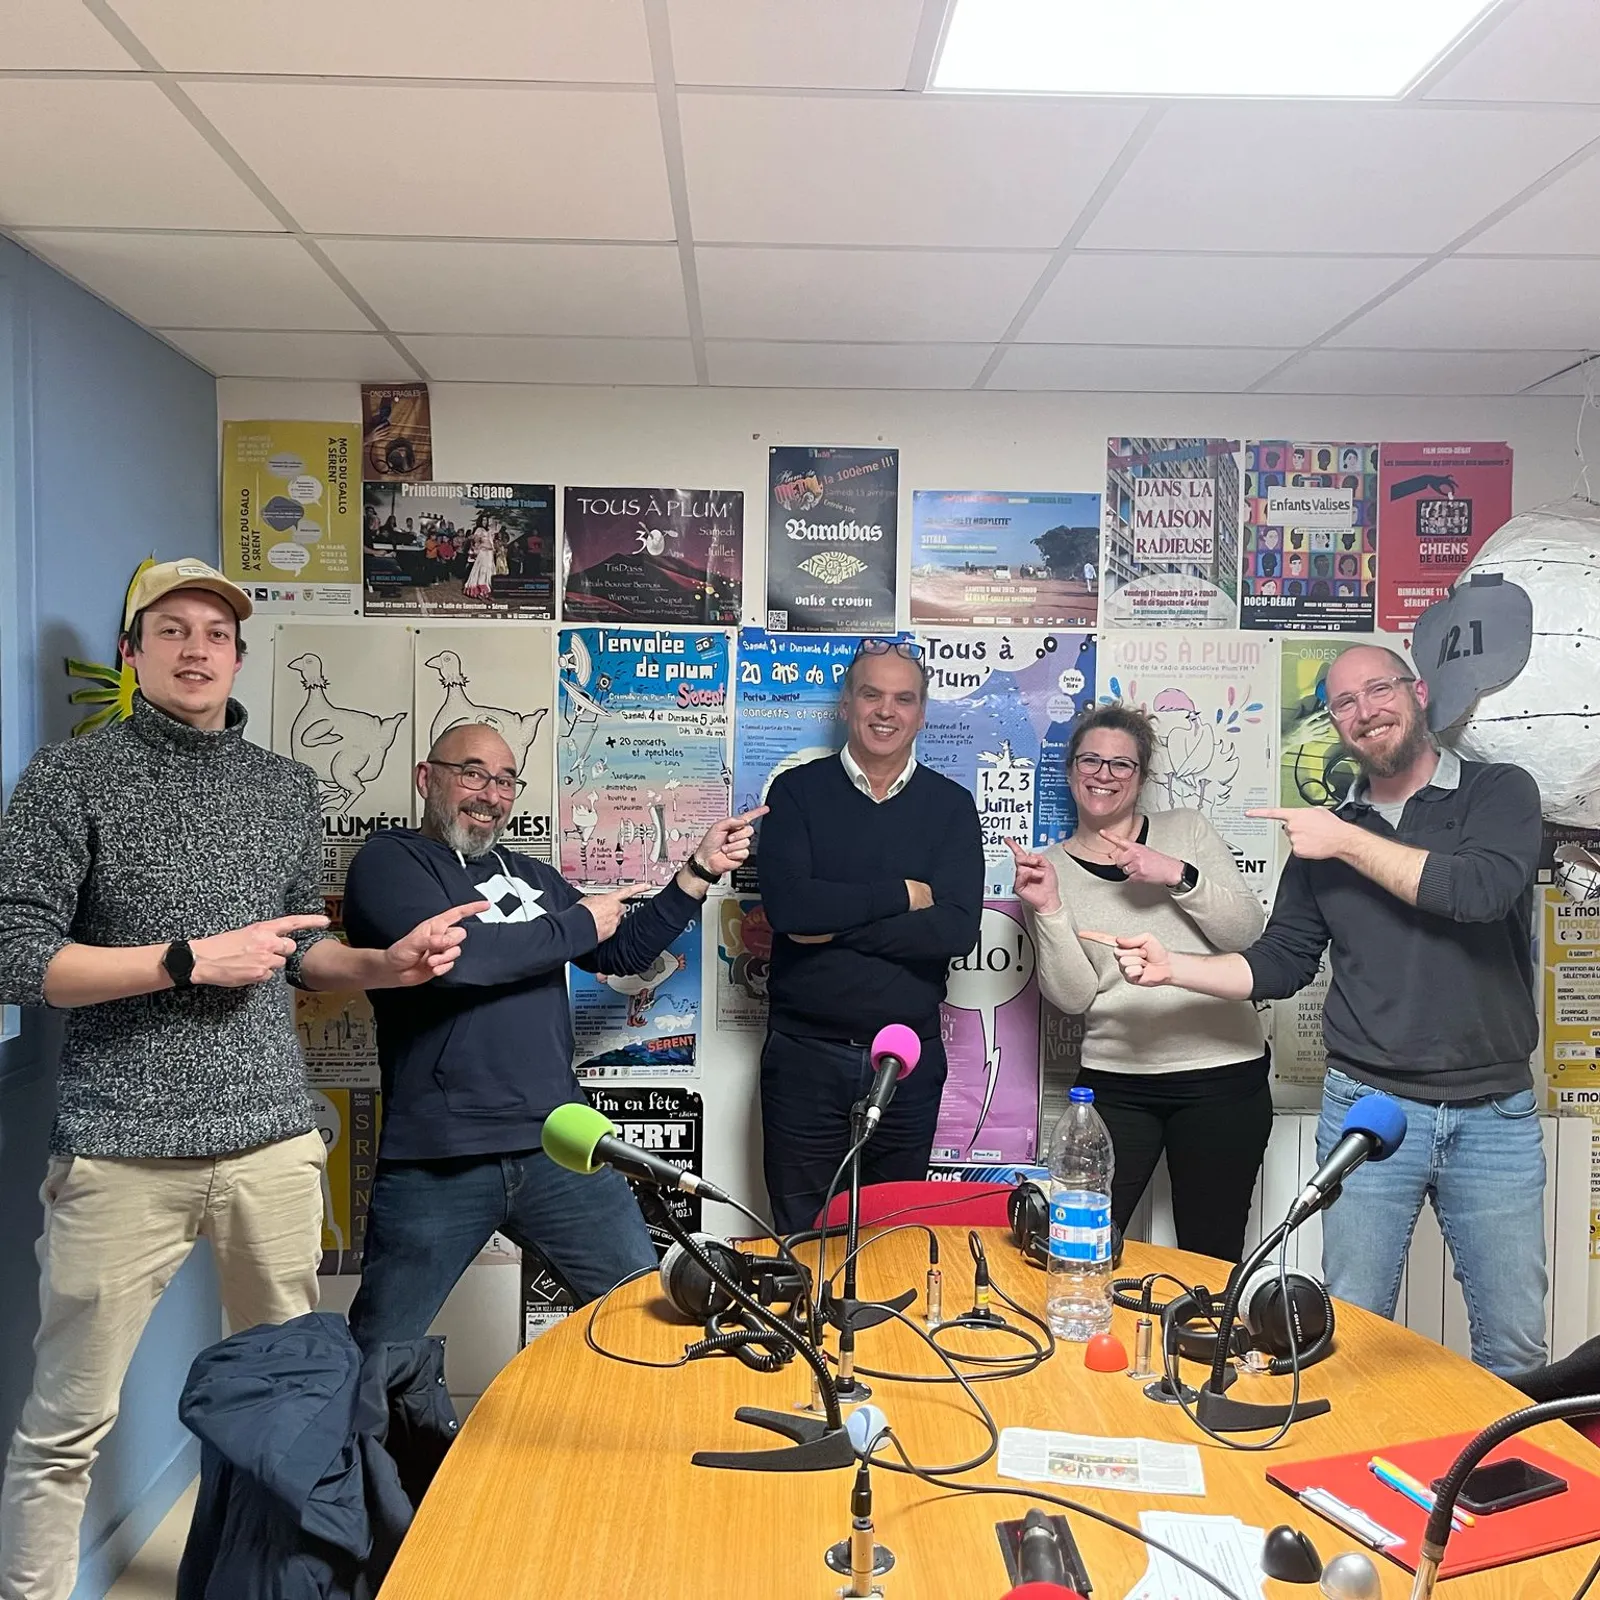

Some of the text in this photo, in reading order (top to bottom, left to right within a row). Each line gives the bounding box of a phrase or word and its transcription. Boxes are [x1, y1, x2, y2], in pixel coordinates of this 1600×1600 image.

[369, 389, 420, 398] ONDES FRAGILES
[339, 467, 347, 480] DU
[824, 475, 834, 484] la
[837, 463, 879, 481] 100ème
[401, 483, 513, 499] Printemps Tsigane
[1137, 480, 1213, 497] DANS LA
[241, 488, 250, 517] GALO
[338, 481, 347, 514] GALLO
[1270, 498, 1350, 511] Enfants Valises
[577, 495, 733, 518] TOUS À PLUM'
[241, 519, 250, 532] DU
[1136, 510, 1212, 528] MAISON
[699, 524, 735, 536] Samedi
[785, 518, 883, 541] Barabbas
[1136, 538, 1213, 554] RADIEUSE
[1420, 543, 1469, 555] CHIENS
[1420, 554, 1467, 563] DE GARDE
[1397, 588, 1434, 596] DIMANCHE
[1244, 596, 1297, 607] DOCU-DÉBAT
[1404, 598, 1430, 607] SÉRENT
[599, 631, 685, 653] l'envolée
[770, 639, 777, 655] 3
[823, 642, 830, 655] 4
[926, 636, 1014, 660] Tous à
[1113, 641, 1168, 663] TOUS
[1300, 648, 1337, 660] ONDES
[636, 655, 718, 682] de plum'
[741, 661, 762, 685] 20
[771, 662, 799, 685] ans
[805, 664, 824, 685] de
[649, 710, 655, 721] 4
[700, 713, 707, 726] 5
[743, 709, 838, 723] concerts et spect
[619, 737, 667, 747] 20 concerts
[924, 753, 957, 763] Samedi 2
[981, 815, 1028, 830] 2011 à
[982, 830, 1028, 845] Sérnt
[1236, 859, 1267, 873] ENT
[1558, 906, 1600, 917] LE MOI
[951, 929, 1024, 973] alo!
[1298, 1003, 1324, 1011] BLUE
[648, 1036, 694, 1053] SERENT
[592, 1091, 680, 1111] 'fm en fête
[1561, 1092, 1573, 1102] LE
[614, 1123, 687, 1149] CERT
